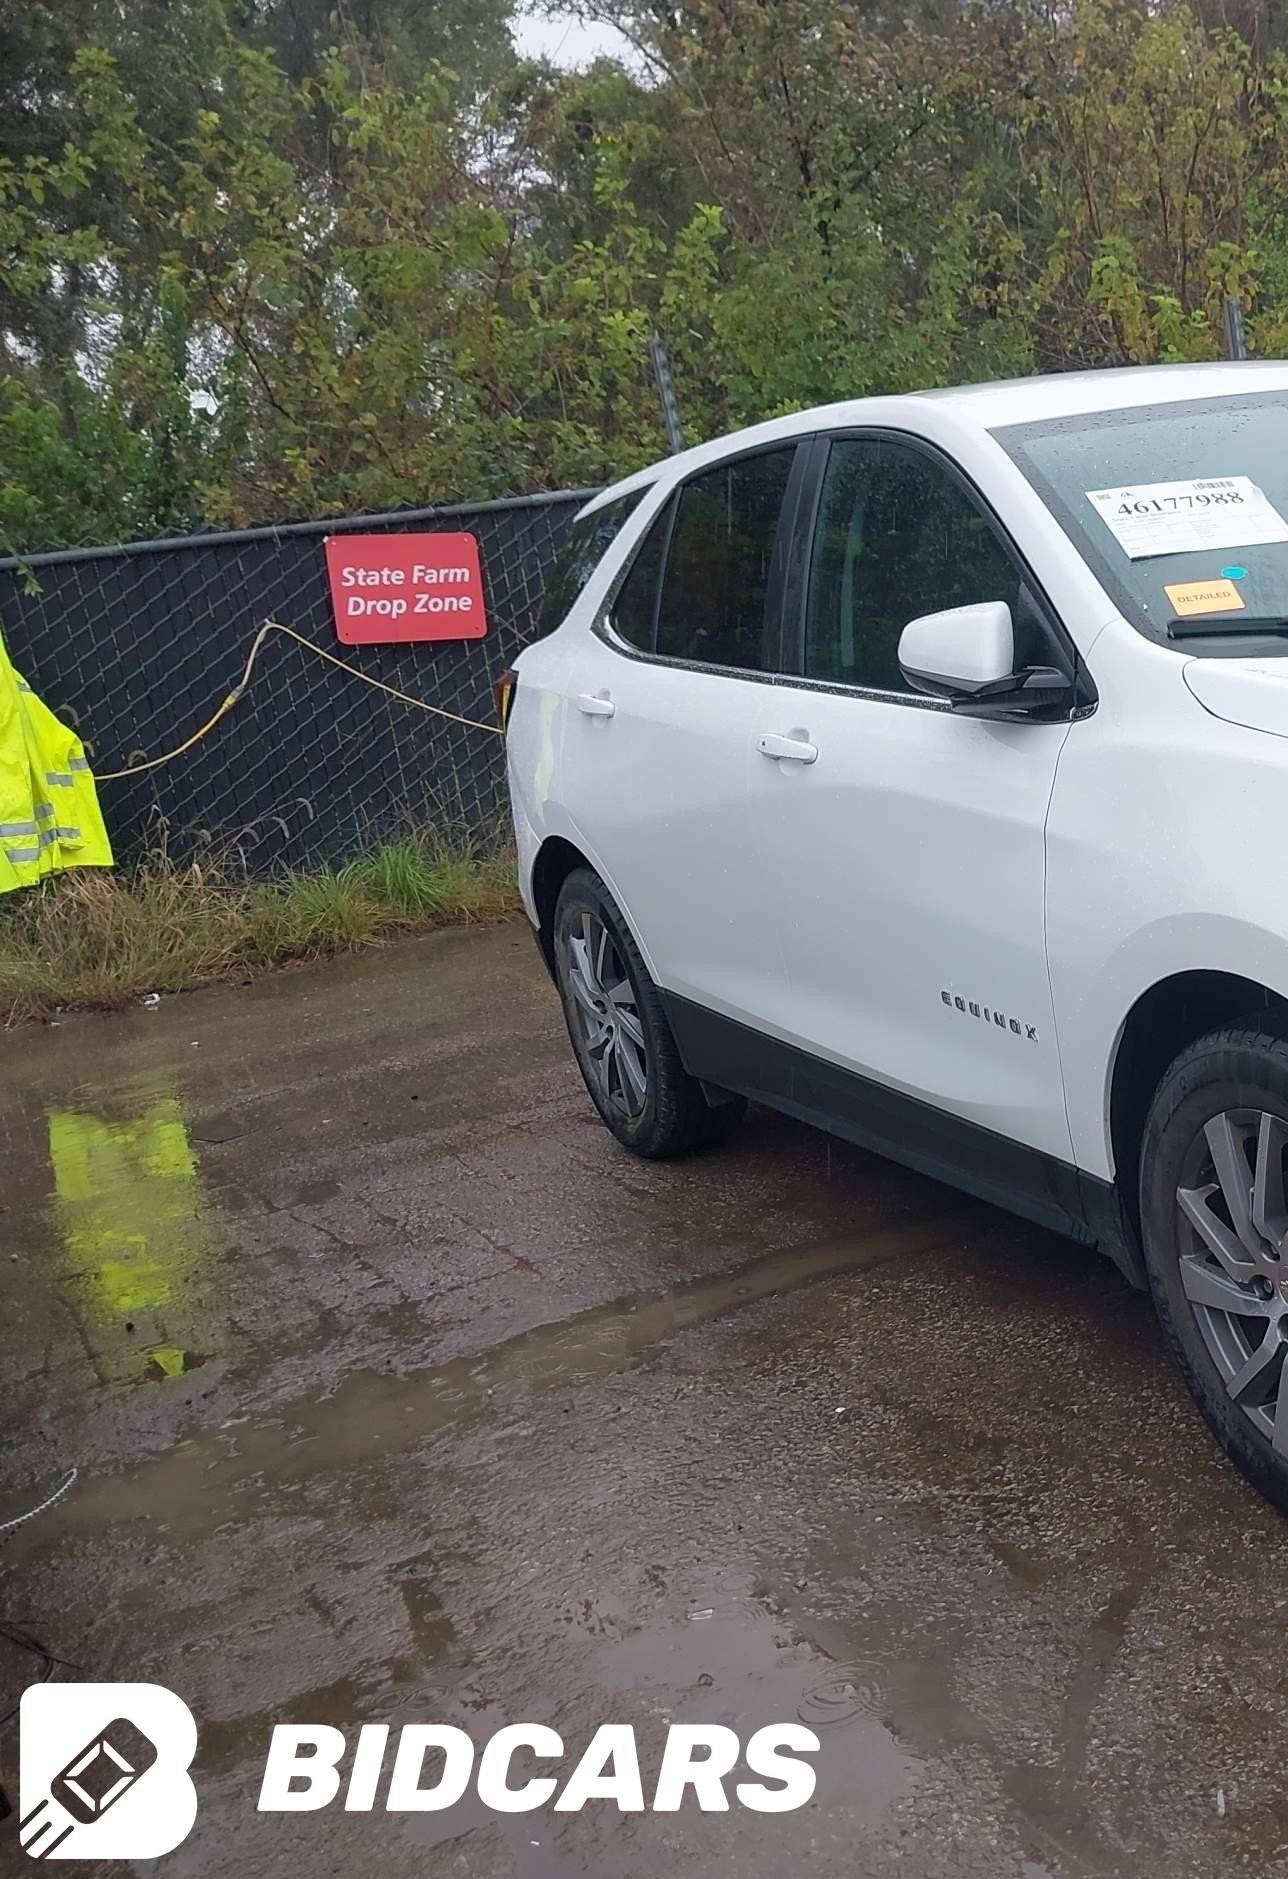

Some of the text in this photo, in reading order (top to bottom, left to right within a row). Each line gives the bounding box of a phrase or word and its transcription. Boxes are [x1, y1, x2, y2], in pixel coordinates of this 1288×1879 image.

[1117, 491, 1244, 516] 46177988
[341, 565, 470, 587] State Farm
[347, 594, 473, 619] Drop Zone
[1177, 590, 1232, 604] DETAILED
[941, 990, 1038, 1043] EQUINOX
